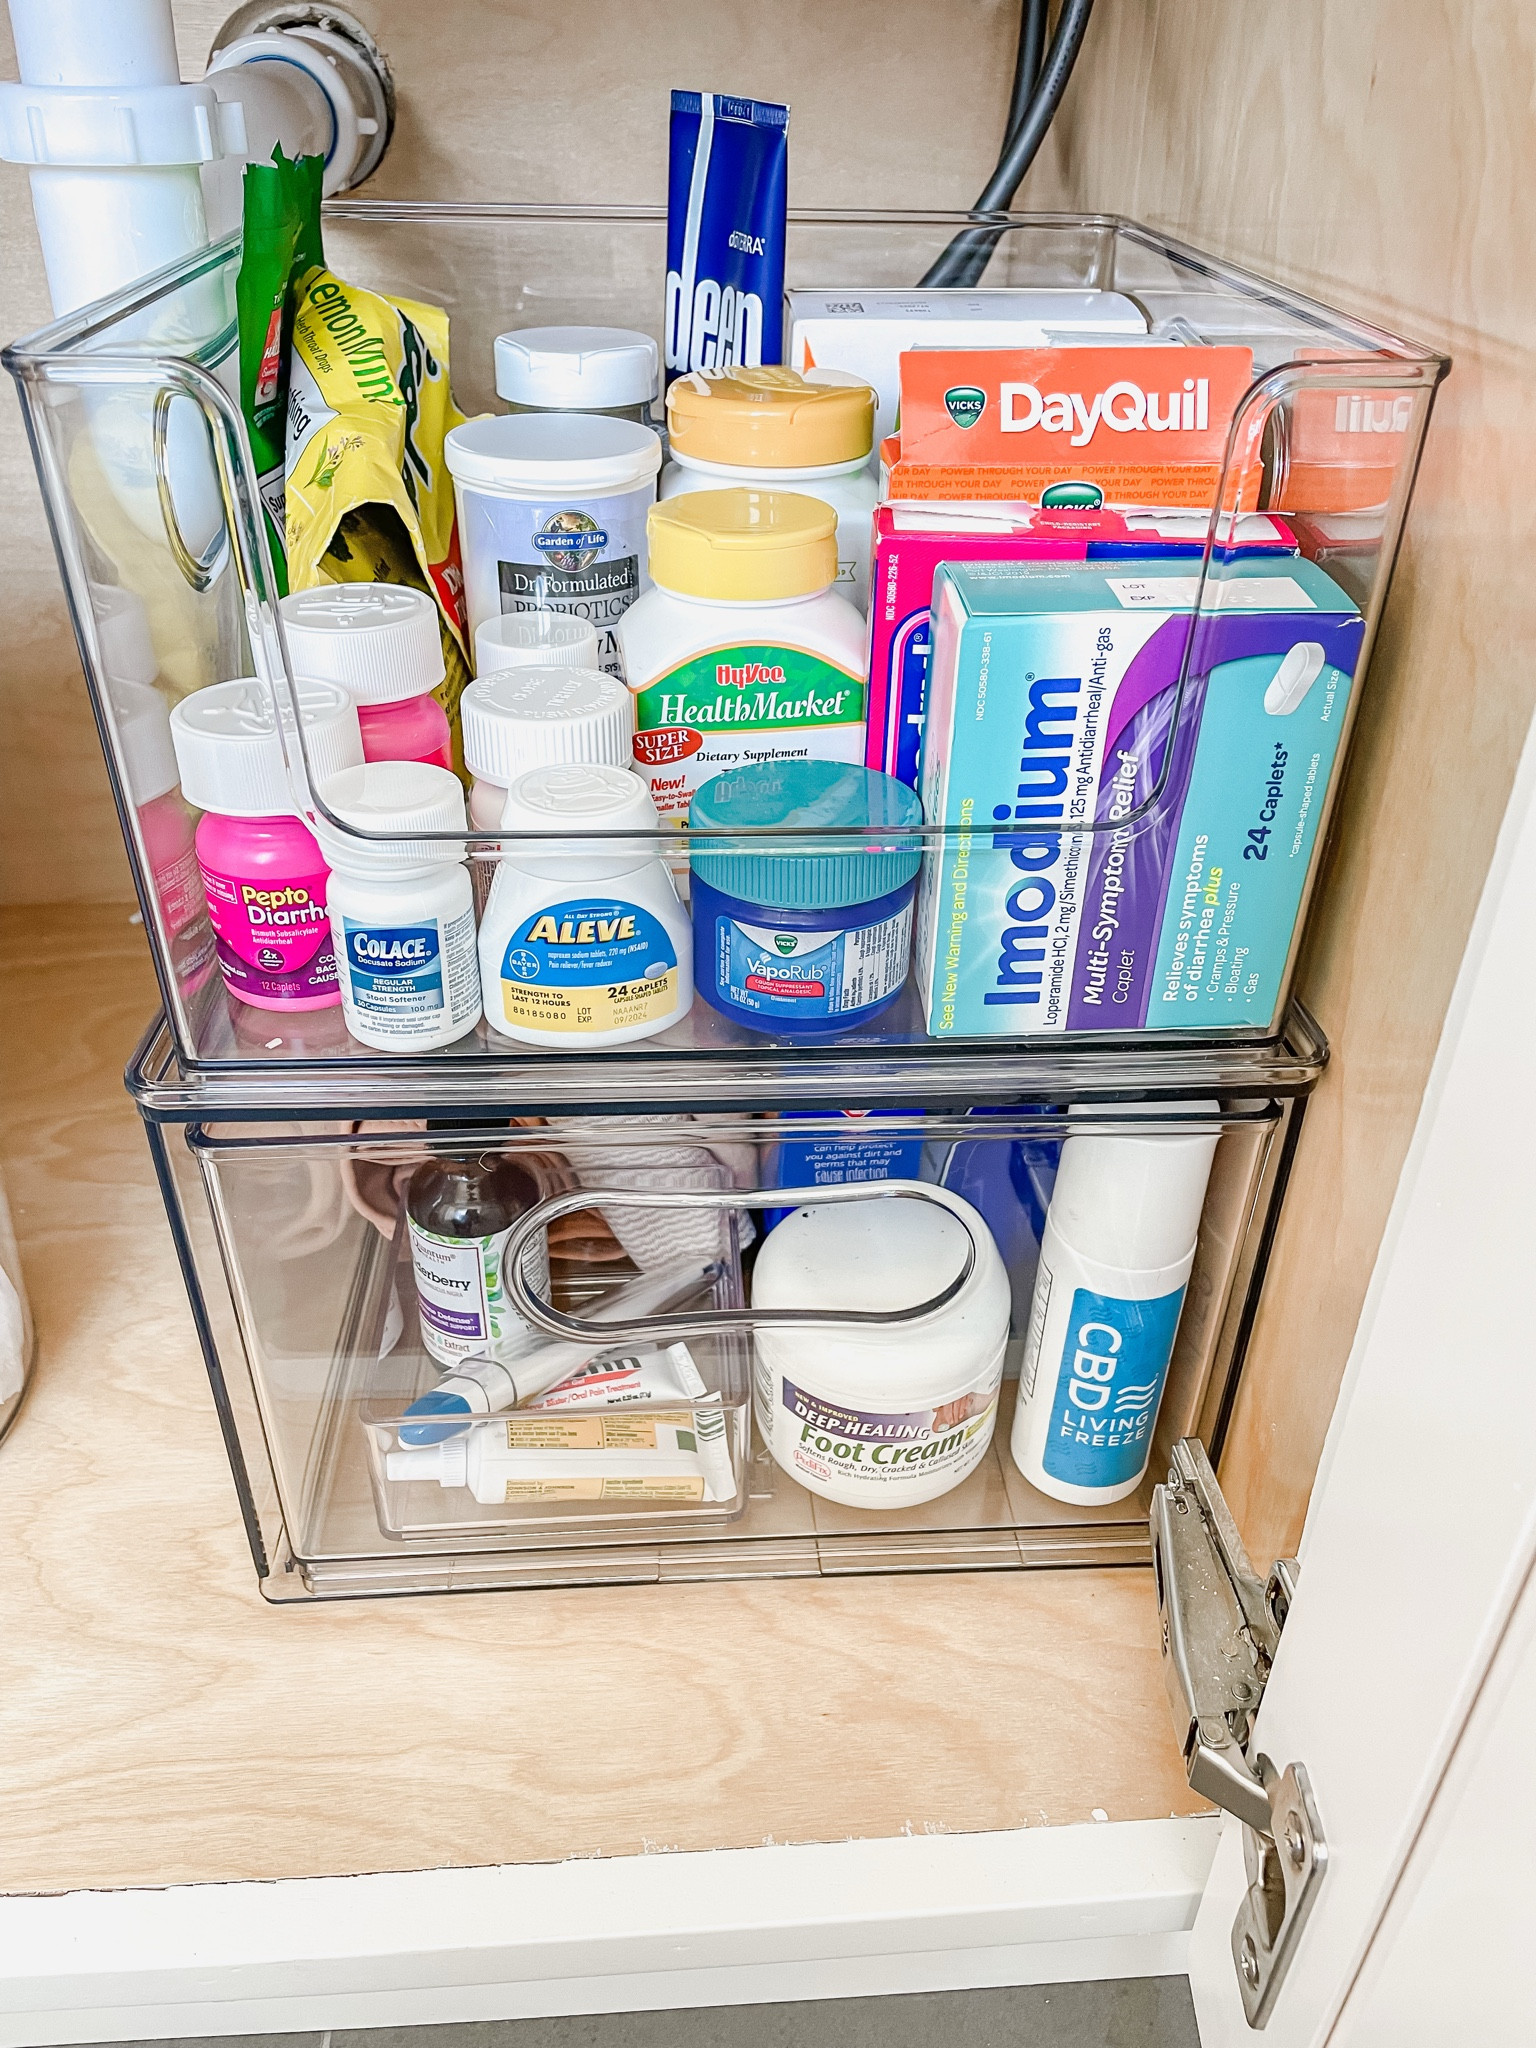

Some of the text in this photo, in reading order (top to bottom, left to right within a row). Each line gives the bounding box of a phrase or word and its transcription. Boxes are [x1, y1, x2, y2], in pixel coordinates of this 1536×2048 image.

[728, 230, 764, 256] doTERRA
[297, 316, 334, 375] Herb Throat Drops
[948, 400, 982, 410] VICKS
[1000, 378, 1209, 447] DayQuil
[911, 467, 931, 476] DAY
[940, 466, 1073, 476] POWER THROUGH YOUR DAY
[1081, 465, 1164, 474] POWER THROUGH
[906, 480, 1002, 489] THROUGH YOUR DAY
[1011, 479, 1045, 488] POWER
[1123, 478, 1142, 487] DAY
[1151, 478, 1186, 486] POWER
[1113, 490, 1208, 500] THROUGH YOUR DAY
[537, 533, 605, 547] Garden of Life
[544, 567, 629, 593] Formulated
[885, 553, 899, 621] NDC 50580-226-52
[975, 631, 993, 721] NDC 50580-338-61
[1076, 626, 1114, 775] Antidiarrheal/Anti-gas
[1320, 669, 1340, 722] Actual Size
[657, 689, 848, 725] HealthMarket
[635, 729, 691, 750] SUPER
[645, 744, 684, 763] SIZE
[696, 747, 808, 763] Dietary Supplement
[1306, 752, 1321, 785] tablets
[651, 774, 686, 792] New!
[1075, 775, 1094, 797] mg
[1069, 797, 1087, 820] 125
[983, 677, 1083, 1007] Imodium
[1243, 825, 1272, 861] 24
[1082, 749, 1142, 1006] Multi-Symptom Relief
[241, 885, 309, 910] Pepto
[247, 900, 330, 926] Diarrh
[939, 797, 974, 1030] See New Warning and Directions
[1162, 833, 1209, 1002] Relieves symptoms
[251, 927, 319, 938] Bismuth Subsalicylate
[527, 914, 636, 944] ALEVE
[1055, 924, 1070, 934] 2
[1184, 866, 1223, 1002] of diarrhea plus
[1206, 882, 1241, 994] Cramps & Pressure
[252, 936, 293, 945] Antidiarrheal
[353, 932, 426, 960] COLACE
[262, 949, 278, 960] 2x
[571, 951, 589, 959] sodium
[608, 948, 619, 957] 220
[619, 948, 627, 956] mg
[627, 941, 649, 954] (NSAID)
[357, 955, 426, 967] Docusate Sodium
[511, 958, 538, 969] BAYER
[548, 960, 613, 970] Pain reliever/fever reducer
[746, 957, 824, 982] VapoRub
[1224, 946, 1250, 994] Bloating
[373, 978, 414, 986] REGULAR
[754, 978, 814, 990] COUGH SUPPRESSANT
[1112, 949, 1136, 1004] Caplet
[1243, 972, 1260, 995] Gas
[261, 981, 301, 993] 12 Caplets
[372, 984, 416, 993] STRENGTH
[511, 986, 551, 999] STRENGTH
[607, 977, 668, 999] 24 CAPLETS
[613, 985, 669, 1004] CAPSULE SHAPED TABLETS
[756, 984, 812, 995] TOPICAL ANALGESIC
[1043, 958, 1066, 1026] Loperamide
[365, 993, 427, 1003] Stool Softener
[511, 994, 571, 1007] LAST 12 HOURS
[770, 995, 797, 1003] Ointment
[365, 1002, 397, 1013] Capsules
[410, 1003, 439, 1012] 100 mg
[513, 1006, 567, 1020] 88185080
[577, 1007, 592, 1015] LOT
[612, 1002, 648, 1016] NAAANR7
[577, 1015, 593, 1023] EXP.
[614, 1012, 648, 1025] 09/2024
[805, 1153, 824, 1162] you
[825, 1151, 861, 1161] against
[813, 1158, 891, 1170] germs that may
[815, 1167, 888, 1184] cause infection
[443, 1338, 471, 1353] Extract
[1068, 1322, 1123, 1411] CBD
[589, 1381, 641, 1399] Pain Treatment
[794, 1391, 859, 1423] NEW IMPROVED
[794, 1400, 931, 1441] DEEP-HEALING
[1063, 1409, 1150, 1432] LIVING
[799, 1423, 866, 1466] Foot
[871, 1427, 965, 1466] Cream
[1060, 1425, 1146, 1447] FREEZE
[798, 1442, 827, 1462] Softens
[827, 1457, 858, 1472] Rough,
[860, 1464, 879, 1475] Dry,
[881, 1462, 917, 1474] Cracked
[918, 1461, 927, 1469] &
[928, 1449, 961, 1467] Callused
[853, 1472, 917, 1482] Hydrating Formula
